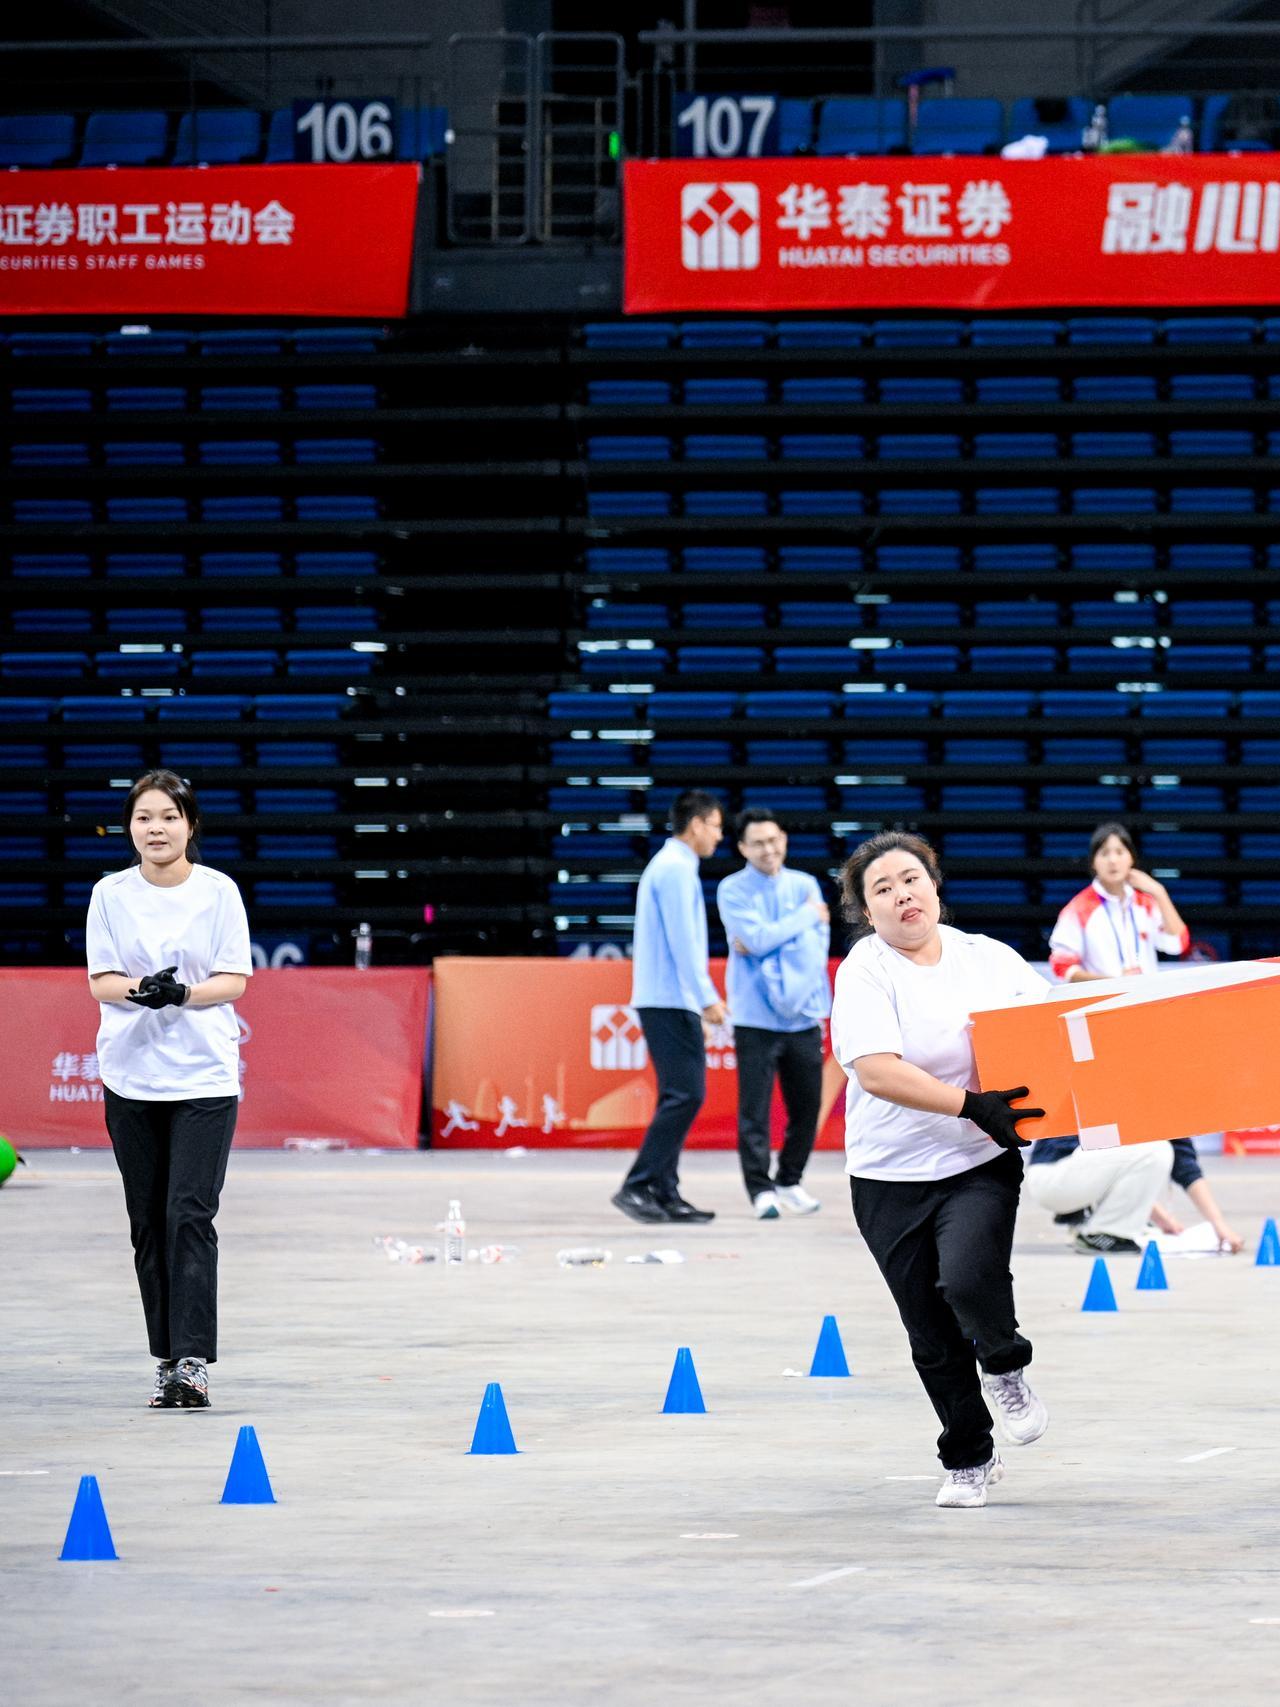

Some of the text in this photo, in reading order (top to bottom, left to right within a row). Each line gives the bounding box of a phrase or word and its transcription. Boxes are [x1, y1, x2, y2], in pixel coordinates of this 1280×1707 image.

[297, 101, 393, 163] 106
[678, 97, 776, 157] 107
[0, 201, 294, 246] 证券职工运动会
[776, 179, 1012, 240] 华泰证券
[85, 254, 139, 270] STAFF
[145, 254, 206, 270] GAMES
[779, 243, 1011, 268] HUATAI SECURITIES
